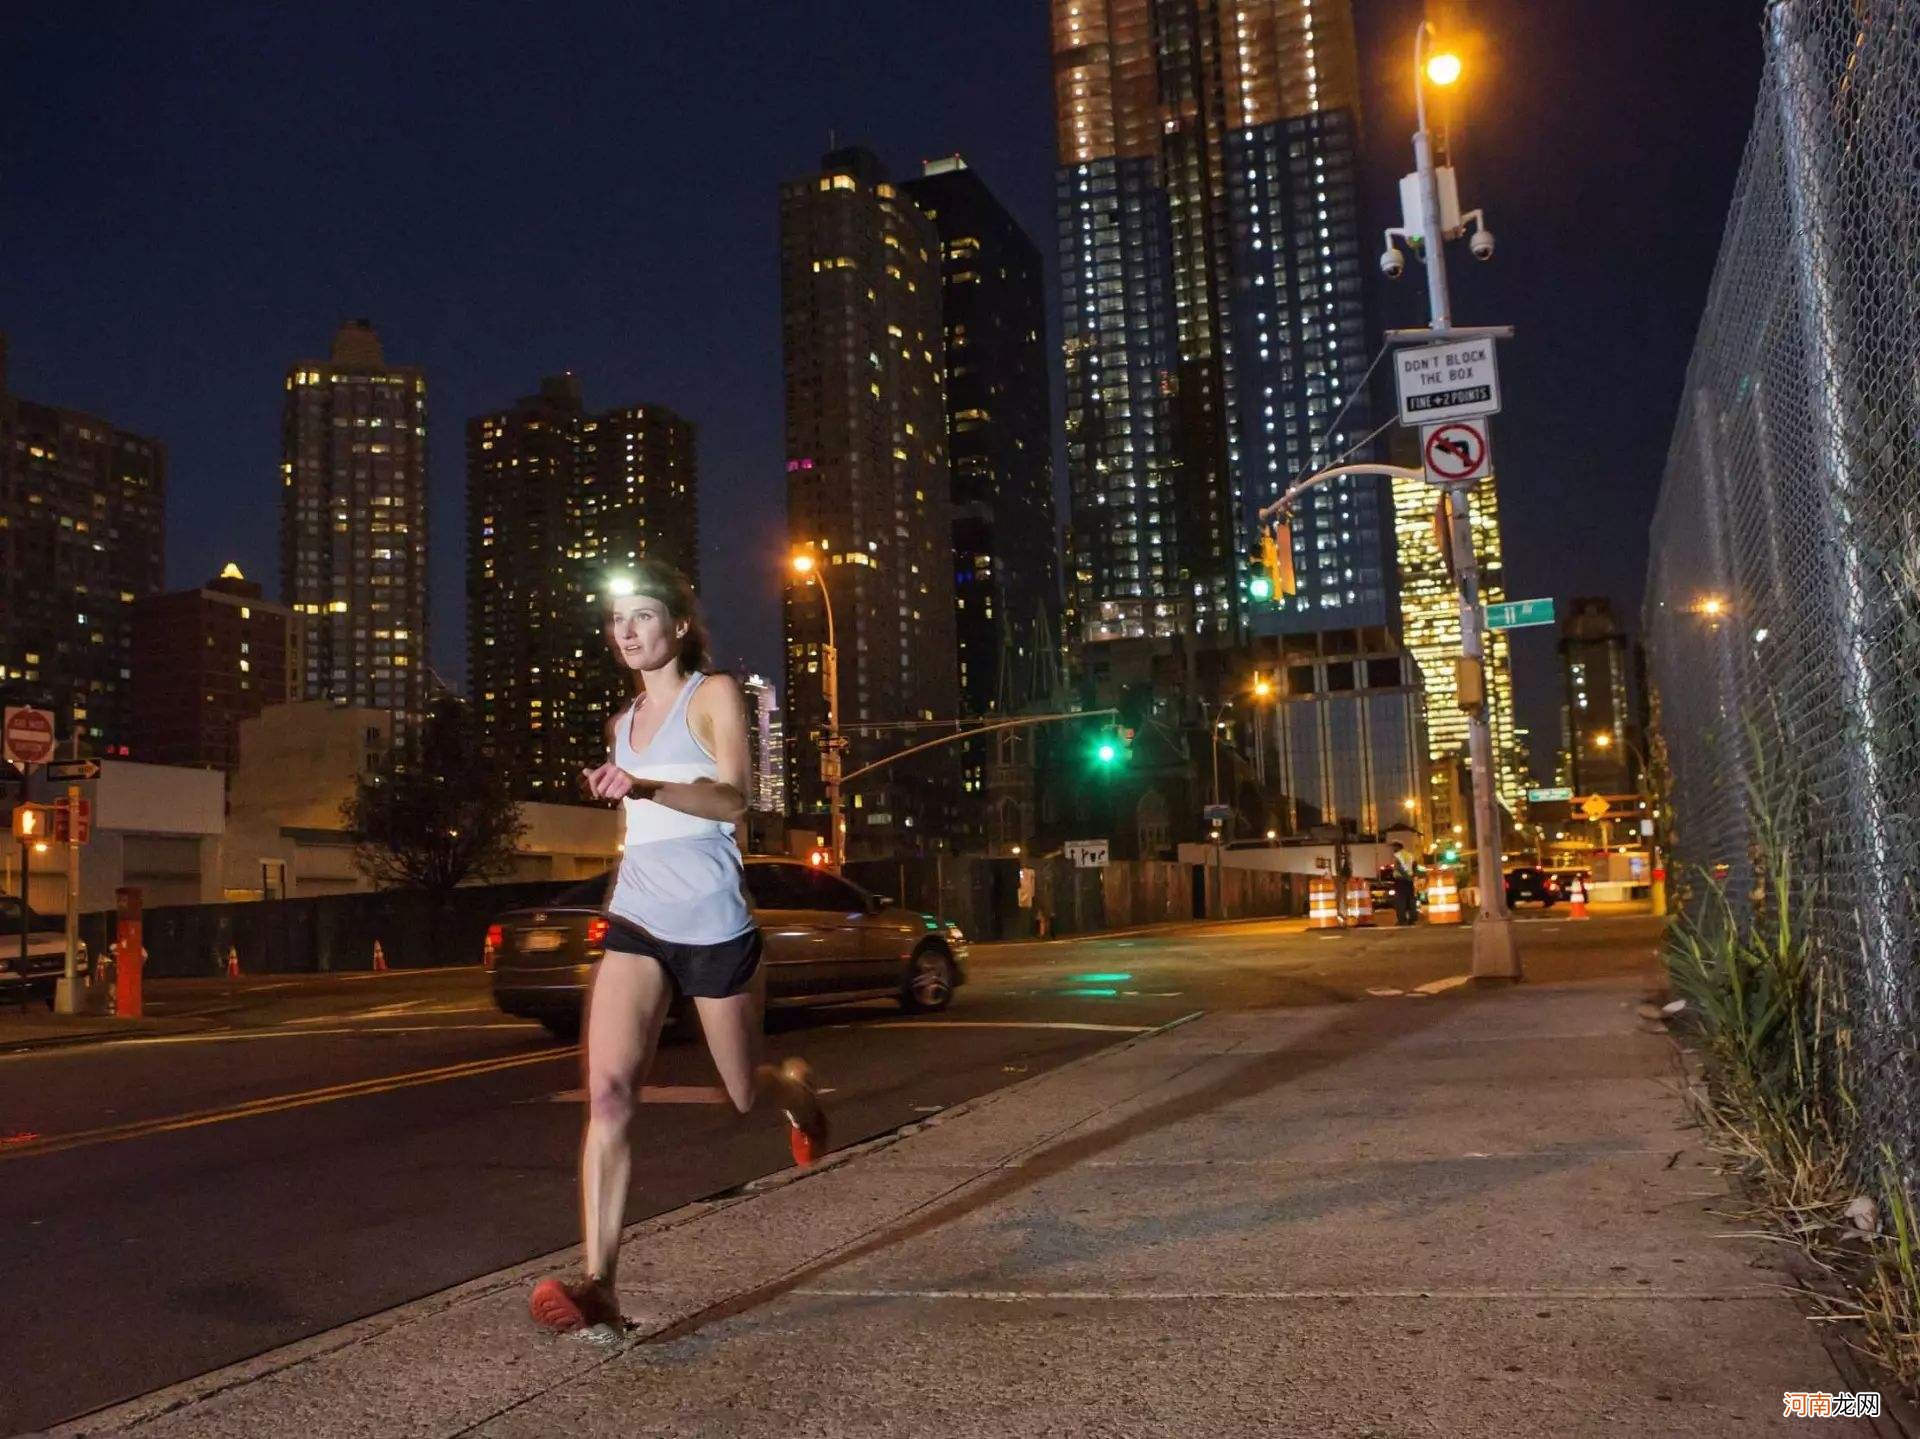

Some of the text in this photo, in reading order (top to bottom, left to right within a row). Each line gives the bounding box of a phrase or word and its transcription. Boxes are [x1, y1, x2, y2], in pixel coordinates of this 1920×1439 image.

[1446, 350, 1486, 366] BLOCK
[1421, 367, 1473, 385] THE BOX
[1410, 396, 1432, 410] FINE
